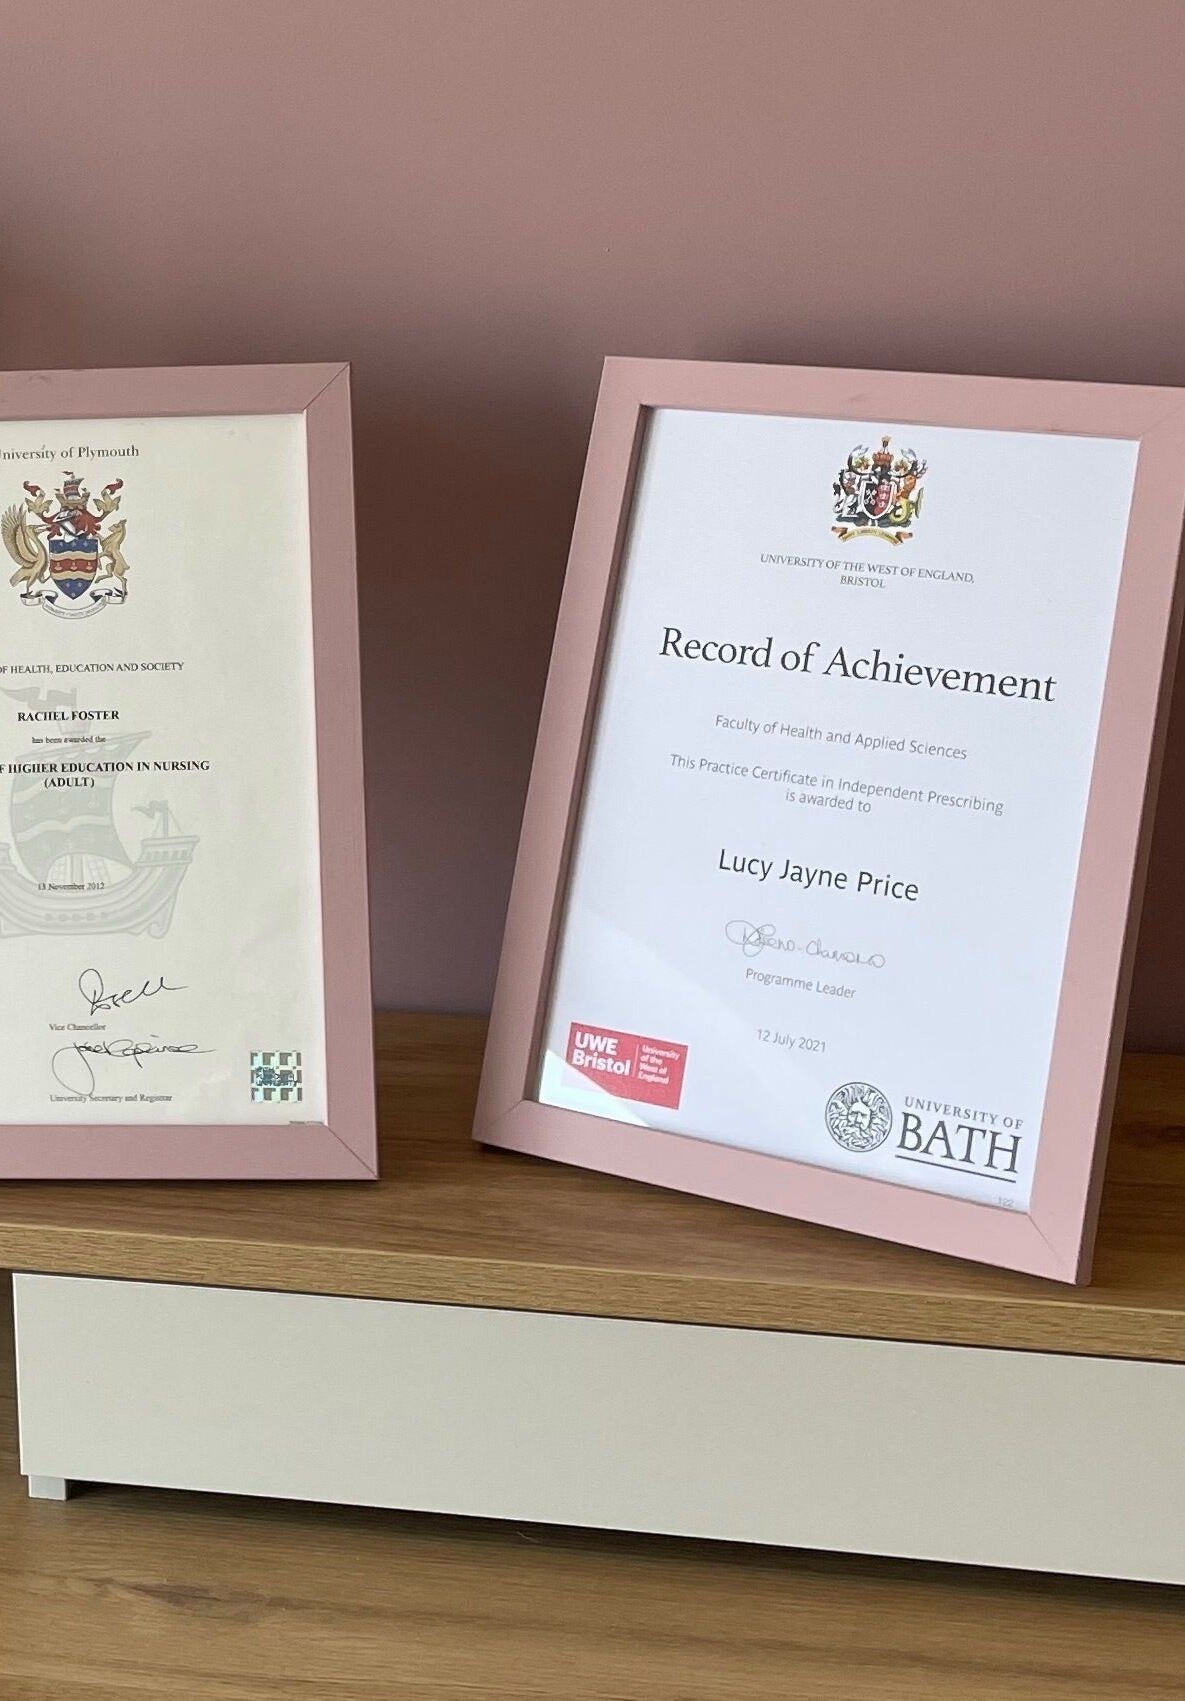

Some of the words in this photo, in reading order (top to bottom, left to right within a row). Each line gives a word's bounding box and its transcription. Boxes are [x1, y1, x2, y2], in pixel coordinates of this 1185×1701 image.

[60, 446, 75, 459] of
[78, 445, 140, 460] Plymouth
[760, 553, 824, 568] UNIVERSITY
[825, 560, 841, 570] OF
[842, 562, 865, 573] THE
[867, 563, 899, 576] WEST
[900, 566, 916, 577] OF
[918, 569, 975, 584] ENGLAND,
[839, 575, 886, 588] BRISTOL
[10, 665, 54, 675] HEALTH,
[56, 664, 114, 673] EDUCATION
[116, 663, 139, 672] AND
[141, 662, 185, 671] SOCIETY
[659, 627, 774, 668] Record
[780, 641, 821, 673] of
[823, 646, 1057, 702] Achievement
[17, 711, 69, 722] RACHEL
[71, 710, 120, 720] FOSTER
[95, 735, 107, 743] the
[715, 715, 761, 735] Faculty
[763, 721, 779, 734] of
[780, 723, 823, 741] Health
[825, 731, 852, 744] and
[855, 733, 906, 751] Applied
[909, 739, 968, 760] Sciences
[8, 763, 58, 774] HIGHER
[61, 762, 134, 773] EDUCATION
[136, 761, 151, 771] IN
[153, 760, 210, 771] NURSING
[44, 777, 95, 789] (ADULT)
[670, 753, 696, 769] This
[699, 758, 749, 777] Practice
[752, 766, 818, 787] Certificate
[821, 775, 834, 788] in
[838, 778, 924, 802] Independent
[928, 790, 1004, 816] Prescribing
[785, 788, 796, 802] is
[798, 793, 854, 810] awarded
[857, 799, 872, 813] to
[718, 849, 774, 882] Lucy
[779, 859, 848, 889] Jayne
[857, 871, 919, 901] Price
[87, 881, 105, 890] 2012
[745, 968, 813, 992] Programme
[816, 981, 857, 999] Leader
[49, 1023, 65, 1031] Vice
[574, 1031, 619, 1056] UWE
[757, 1029, 771, 1042] 12
[773, 1032, 796, 1049] July
[798, 1036, 826, 1053] 2021
[640, 1054, 650, 1062] of
[641, 1045, 681, 1060] University
[571, 1049, 631, 1076] Bristol
[124, 1094, 138, 1102] and
[904, 1096, 999, 1125] UNIVERSITY
[1002, 1116, 1024, 1130] OF
[896, 1112, 1023, 1174] BATH
